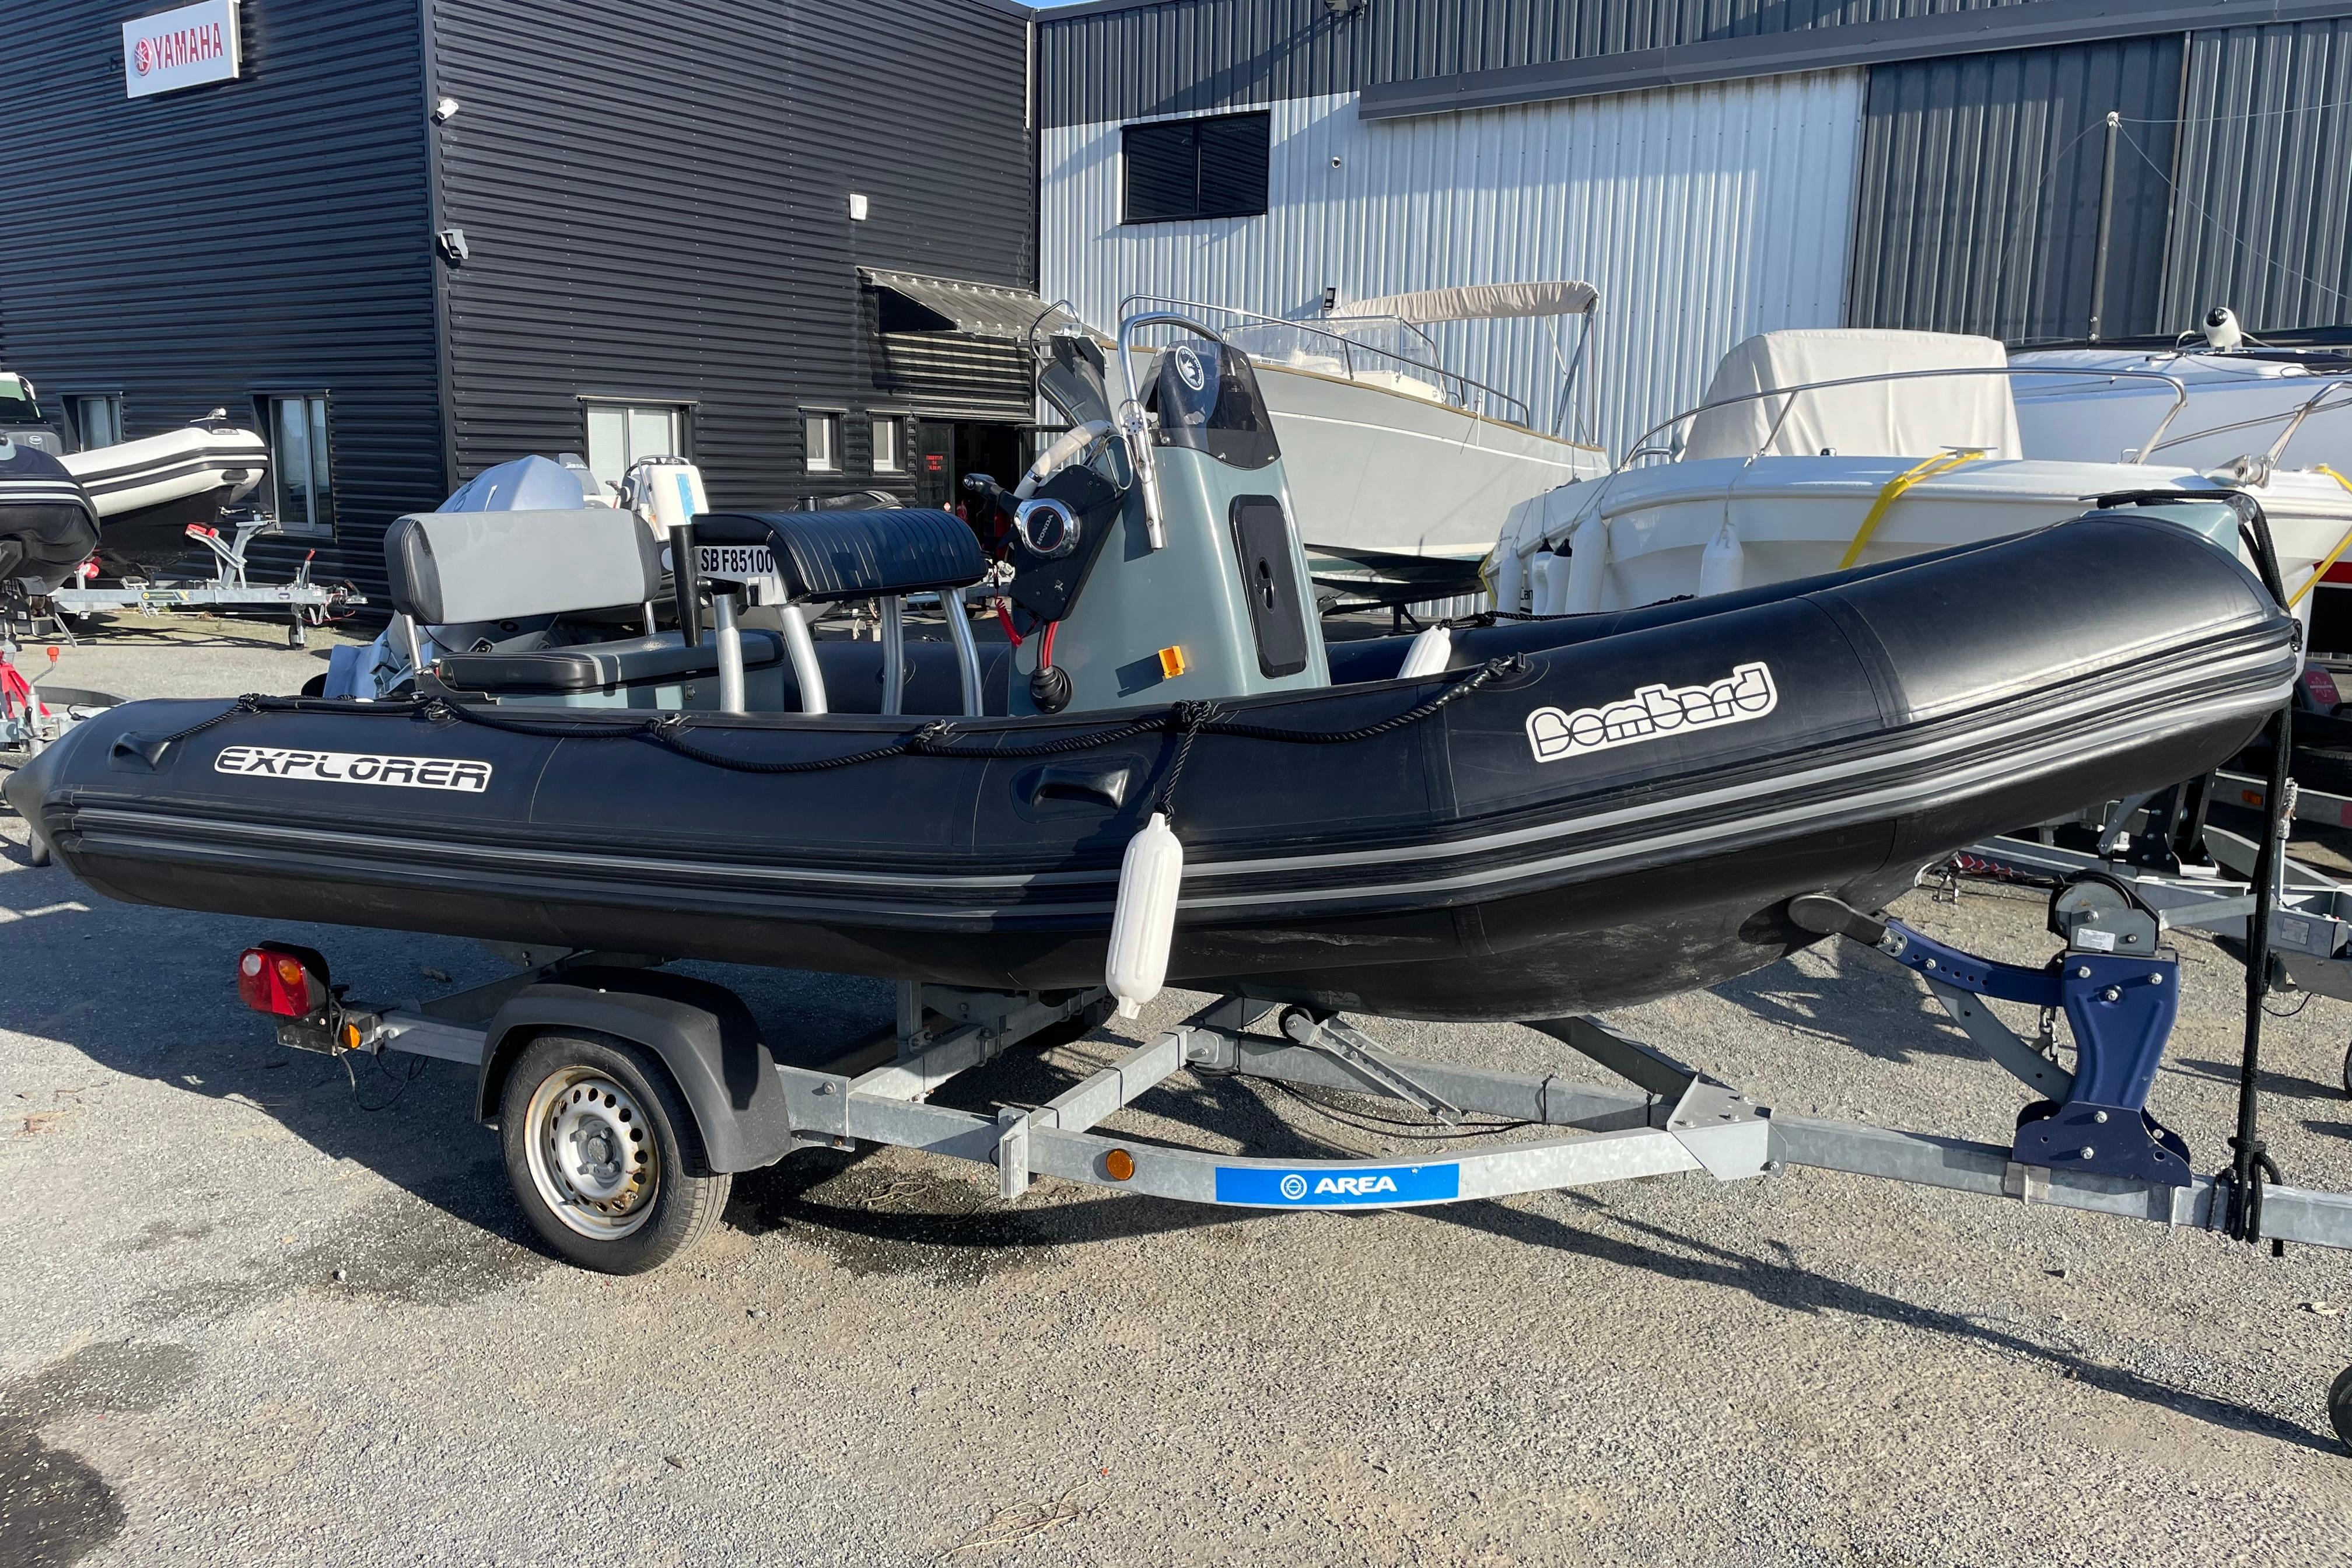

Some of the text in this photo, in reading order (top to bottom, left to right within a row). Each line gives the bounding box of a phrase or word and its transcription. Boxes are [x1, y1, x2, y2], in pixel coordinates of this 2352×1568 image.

[152, 23, 223, 69] YAMAHA
[1037, 514, 1054, 545] HONDA
[1531, 668, 1770, 757] Bombard
[216, 748, 488, 789] EXPLORER
[1314, 1175, 1398, 1195] AREA
